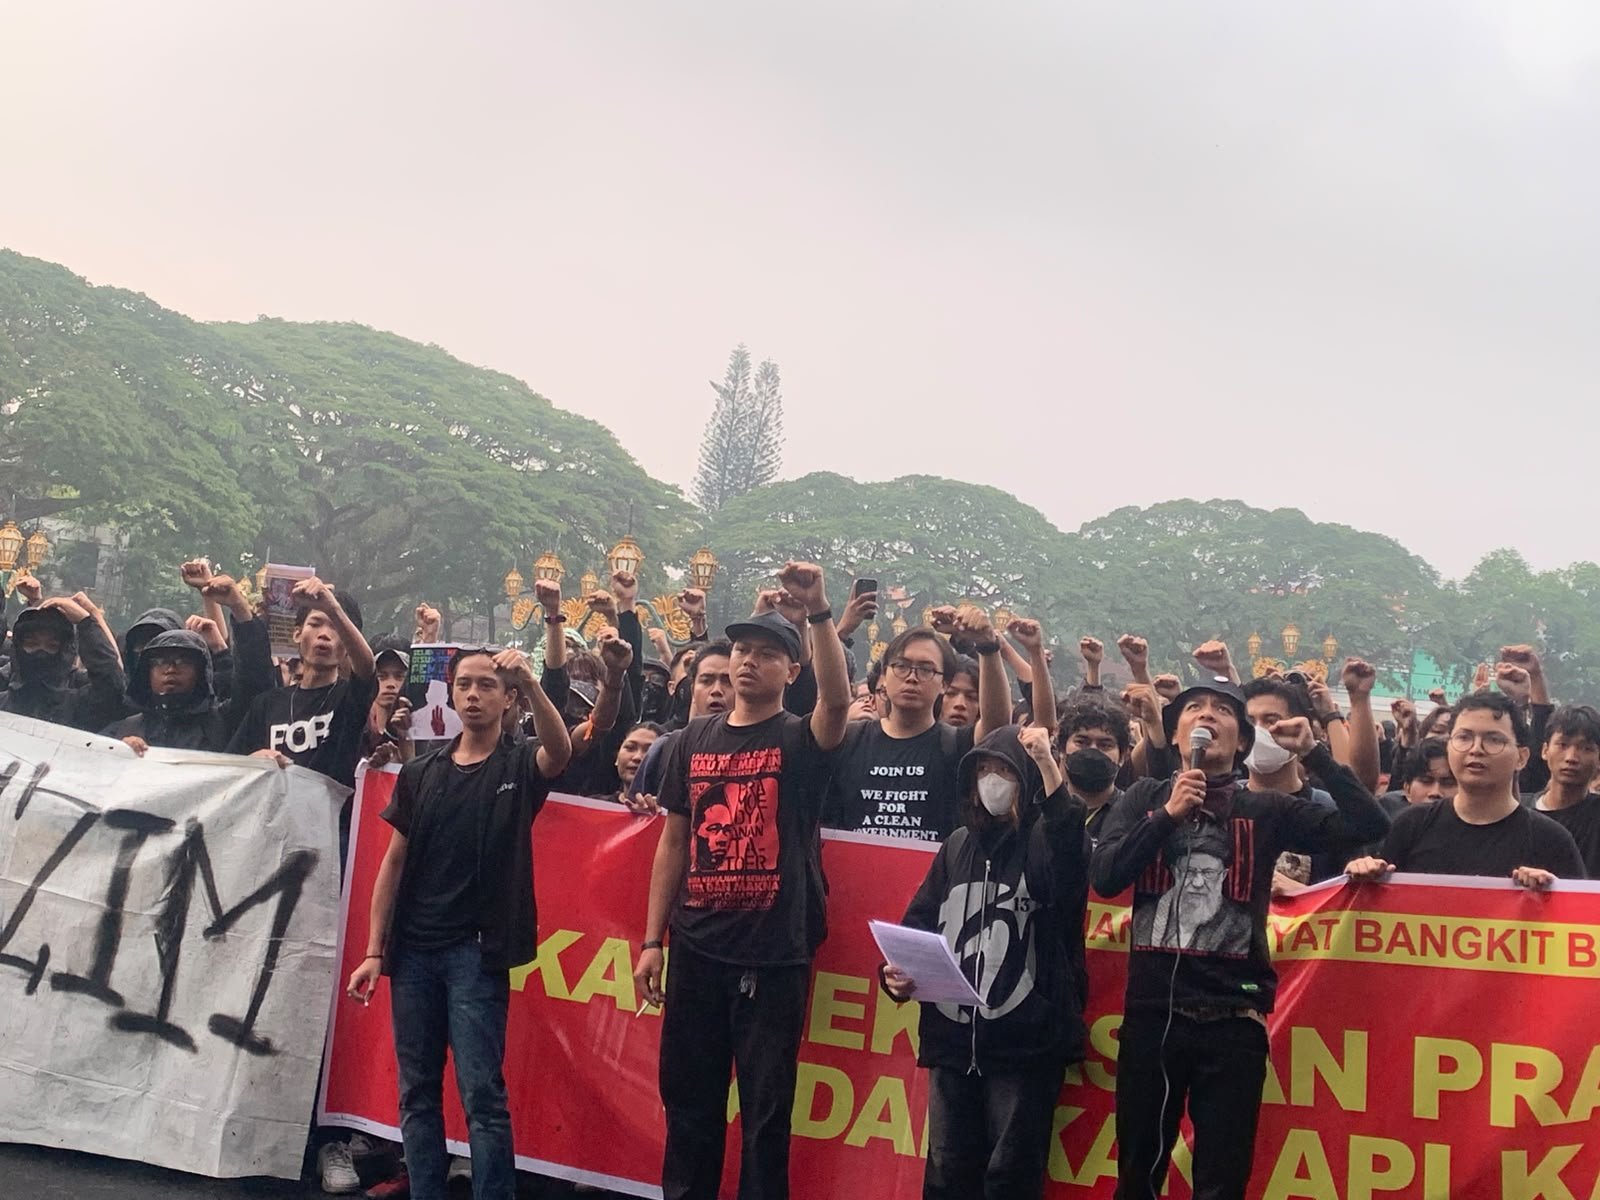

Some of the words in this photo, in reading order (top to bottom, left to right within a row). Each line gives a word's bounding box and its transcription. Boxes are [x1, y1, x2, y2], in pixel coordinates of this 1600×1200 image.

[870, 766, 904, 776] JOIN
[906, 766, 924, 776] US
[860, 789, 883, 800] WE
[885, 790, 928, 801] FIGHT
[878, 802, 906, 813] FOR
[862, 815, 871, 825] A
[874, 815, 921, 826] CLEAN
[853, 828, 938, 841] VERNMENT
[1354, 919, 1554, 967] BANGKIT
[1261, 1128, 1451, 1200] API
